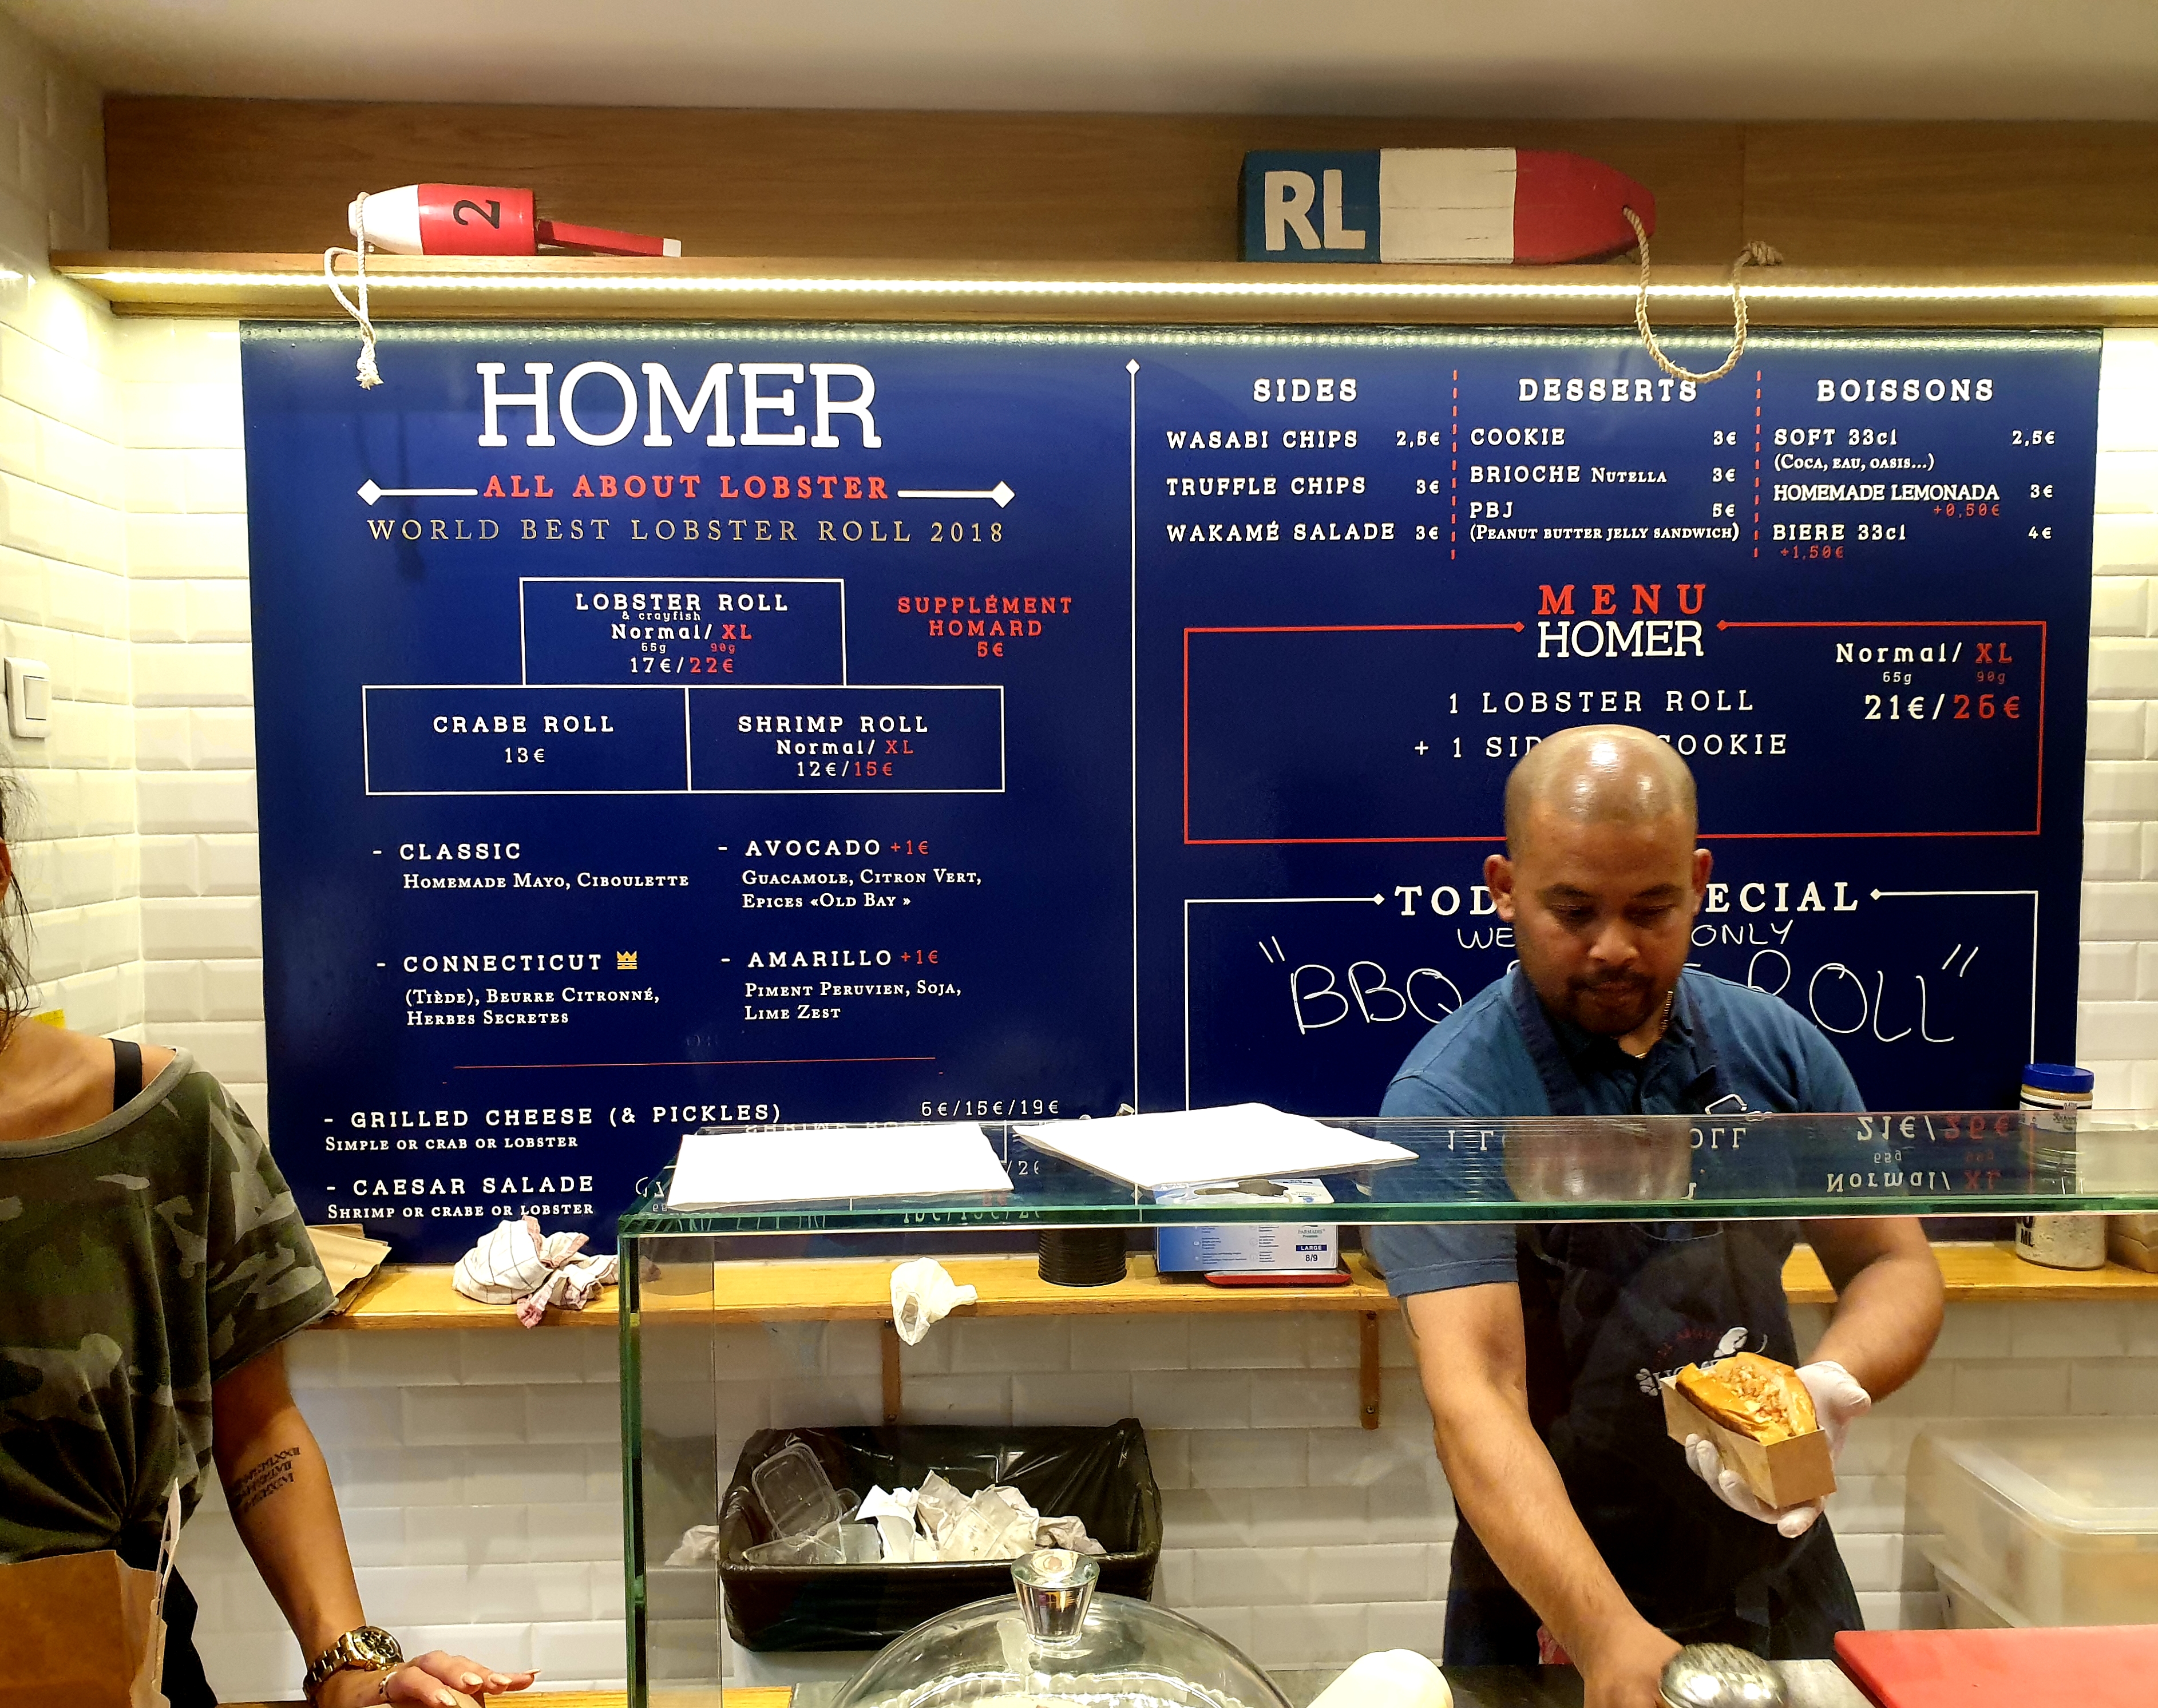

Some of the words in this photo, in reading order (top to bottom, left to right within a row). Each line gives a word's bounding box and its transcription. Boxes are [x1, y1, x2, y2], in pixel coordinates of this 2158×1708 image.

[452, 197, 501, 230] 2
[1264, 169, 1367, 252] RL
[1254, 379, 1356, 402] SIDES
[1519, 378, 1697, 402] DESSERTS
[1817, 379, 1992, 402] BOISSONS
[477, 362, 881, 447] HOMER
[1167, 431, 1268, 449] WASABI
[1283, 430, 1356, 448] CHIPS
[1397, 431, 1439, 447] 2,5€
[1471, 428, 1564, 445] COOKIE
[1714, 431, 1736, 445] 3€
[1775, 429, 1835, 445] SOFT
[1849, 429, 1896, 445] 33cl
[2013, 430, 2054, 446] 2,5€
[1471, 466, 1579, 482] BRIOCHE
[1713, 467, 1735, 482] 3€
[484, 475, 553, 497] ALL
[573, 475, 700, 498] ABOUT
[720, 476, 888, 498] LOBSTER
[1167, 478, 1276, 496] TRUFFLE
[1291, 477, 1364, 494] CHIPS
[1417, 479, 1439, 494] 3€
[1773, 485, 1884, 501] HOMEMADE
[1891, 485, 1999, 501] LEMONADA
[2031, 485, 2053, 498] 3€
[1470, 502, 1512, 518] PBJ
[1713, 504, 1735, 517] 5€
[367, 520, 498, 540] WORLD
[521, 519, 609, 539] BEST
[631, 520, 797, 540] LOBSTER
[818, 521, 910, 541] ROLL
[931, 522, 1001, 542] 2018
[1167, 521, 1278, 542] WAKAMÉ
[1294, 523, 1394, 540] SALADE
[1416, 526, 1438, 540] 3€
[1773, 524, 1844, 540] BIERE
[1859, 524, 1905, 540] 33cl
[2029, 526, 2051, 539] 4€
[576, 593, 700, 611] LOBSTER
[719, 594, 787, 611] ROLL
[898, 595, 1071, 613] SUPPLÉMENT
[1538, 584, 1705, 615] MENU
[622, 611, 629, 620] &
[639, 611, 700, 622] crayfish
[722, 624, 751, 639] XL
[929, 620, 1041, 636] HOMARD
[642, 643, 666, 653] 65g
[1538, 621, 1704, 657] HOMER
[978, 641, 1003, 657] 5€
[1975, 643, 2012, 663] XL
[1883, 672, 1911, 685] 65g
[1450, 693, 1458, 714] 1
[1483, 691, 1641, 712] LOBSTER
[1666, 690, 1752, 711] ROLL
[434, 716, 526, 732] CRABE
[544, 716, 613, 732] ROLL
[739, 716, 842, 732] SHRIMP
[861, 716, 927, 732] ROLL
[885, 740, 913, 754] XL
[1454, 738, 1461, 757] 1
[1486, 736, 1541, 758] SID
[1658, 734, 1786, 756] OOKIE
[505, 748, 544, 763] 13€
[400, 843, 520, 860] CLASSIC
[745, 839, 879, 856] AVOCADO
[891, 841, 928, 854] +1€
[1395, 885, 1497, 916] TOD
[1705, 881, 1858, 913] ECIAL
[1691, 920, 1793, 946] ONLY
[404, 954, 601, 972] CONNECTICUT
[748, 950, 890, 968] AMARILLO
[901, 950, 938, 964] +1€
[351, 1111, 468, 1128] GRILLED
[486, 1108, 591, 1126] CHEESE
[653, 1104, 779, 1123] PICKLES)
[354, 1179, 465, 1195] CAESAR
[483, 1176, 592, 1193] SALADE
